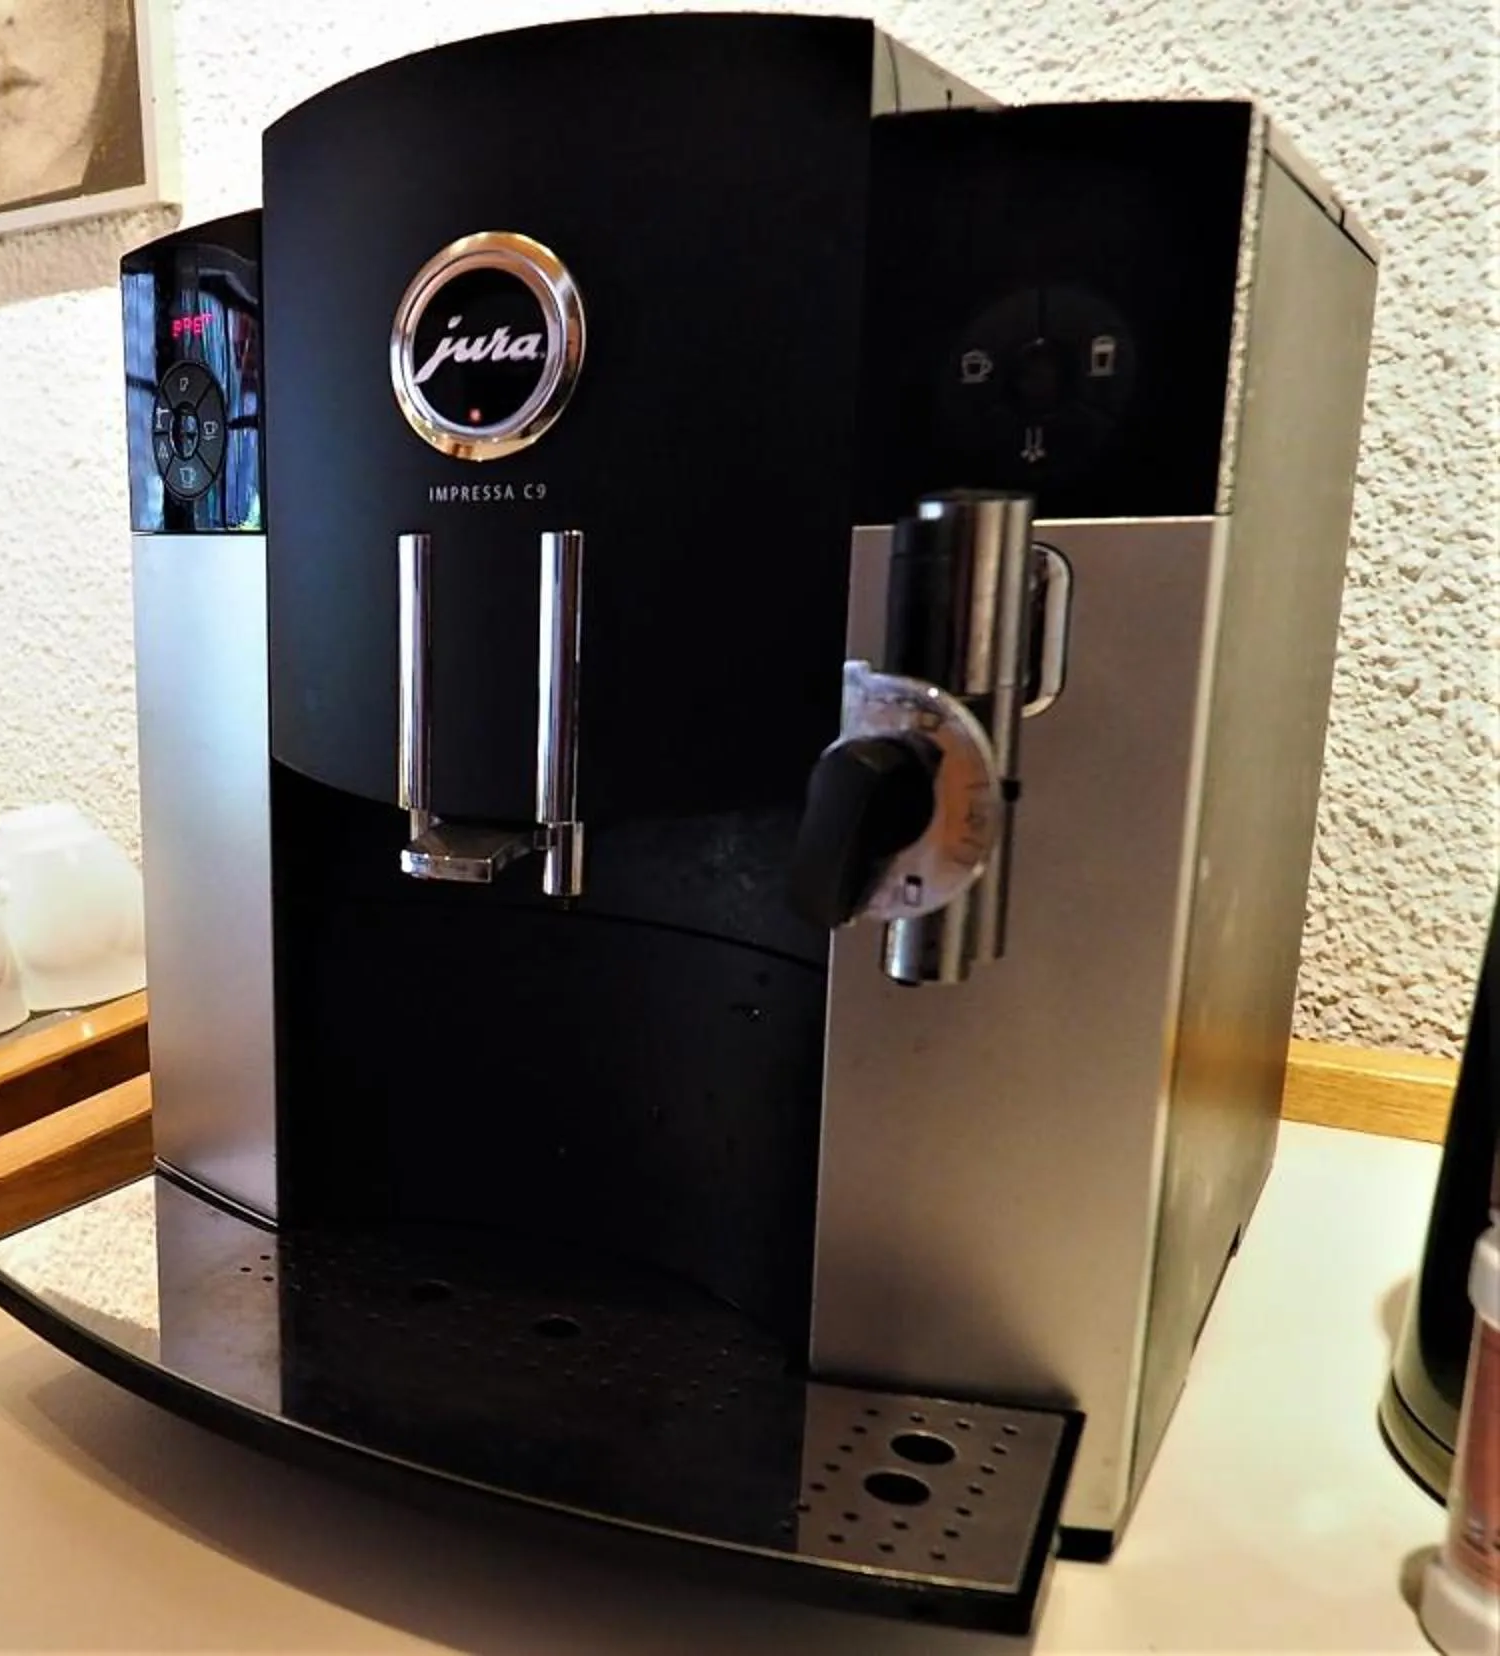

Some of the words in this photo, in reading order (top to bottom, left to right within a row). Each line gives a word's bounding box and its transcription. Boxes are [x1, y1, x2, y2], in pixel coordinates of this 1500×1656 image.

[412, 315, 543, 384] jura
[428, 483, 515, 502] IMPRESSA
[523, 483, 547, 499] C9
